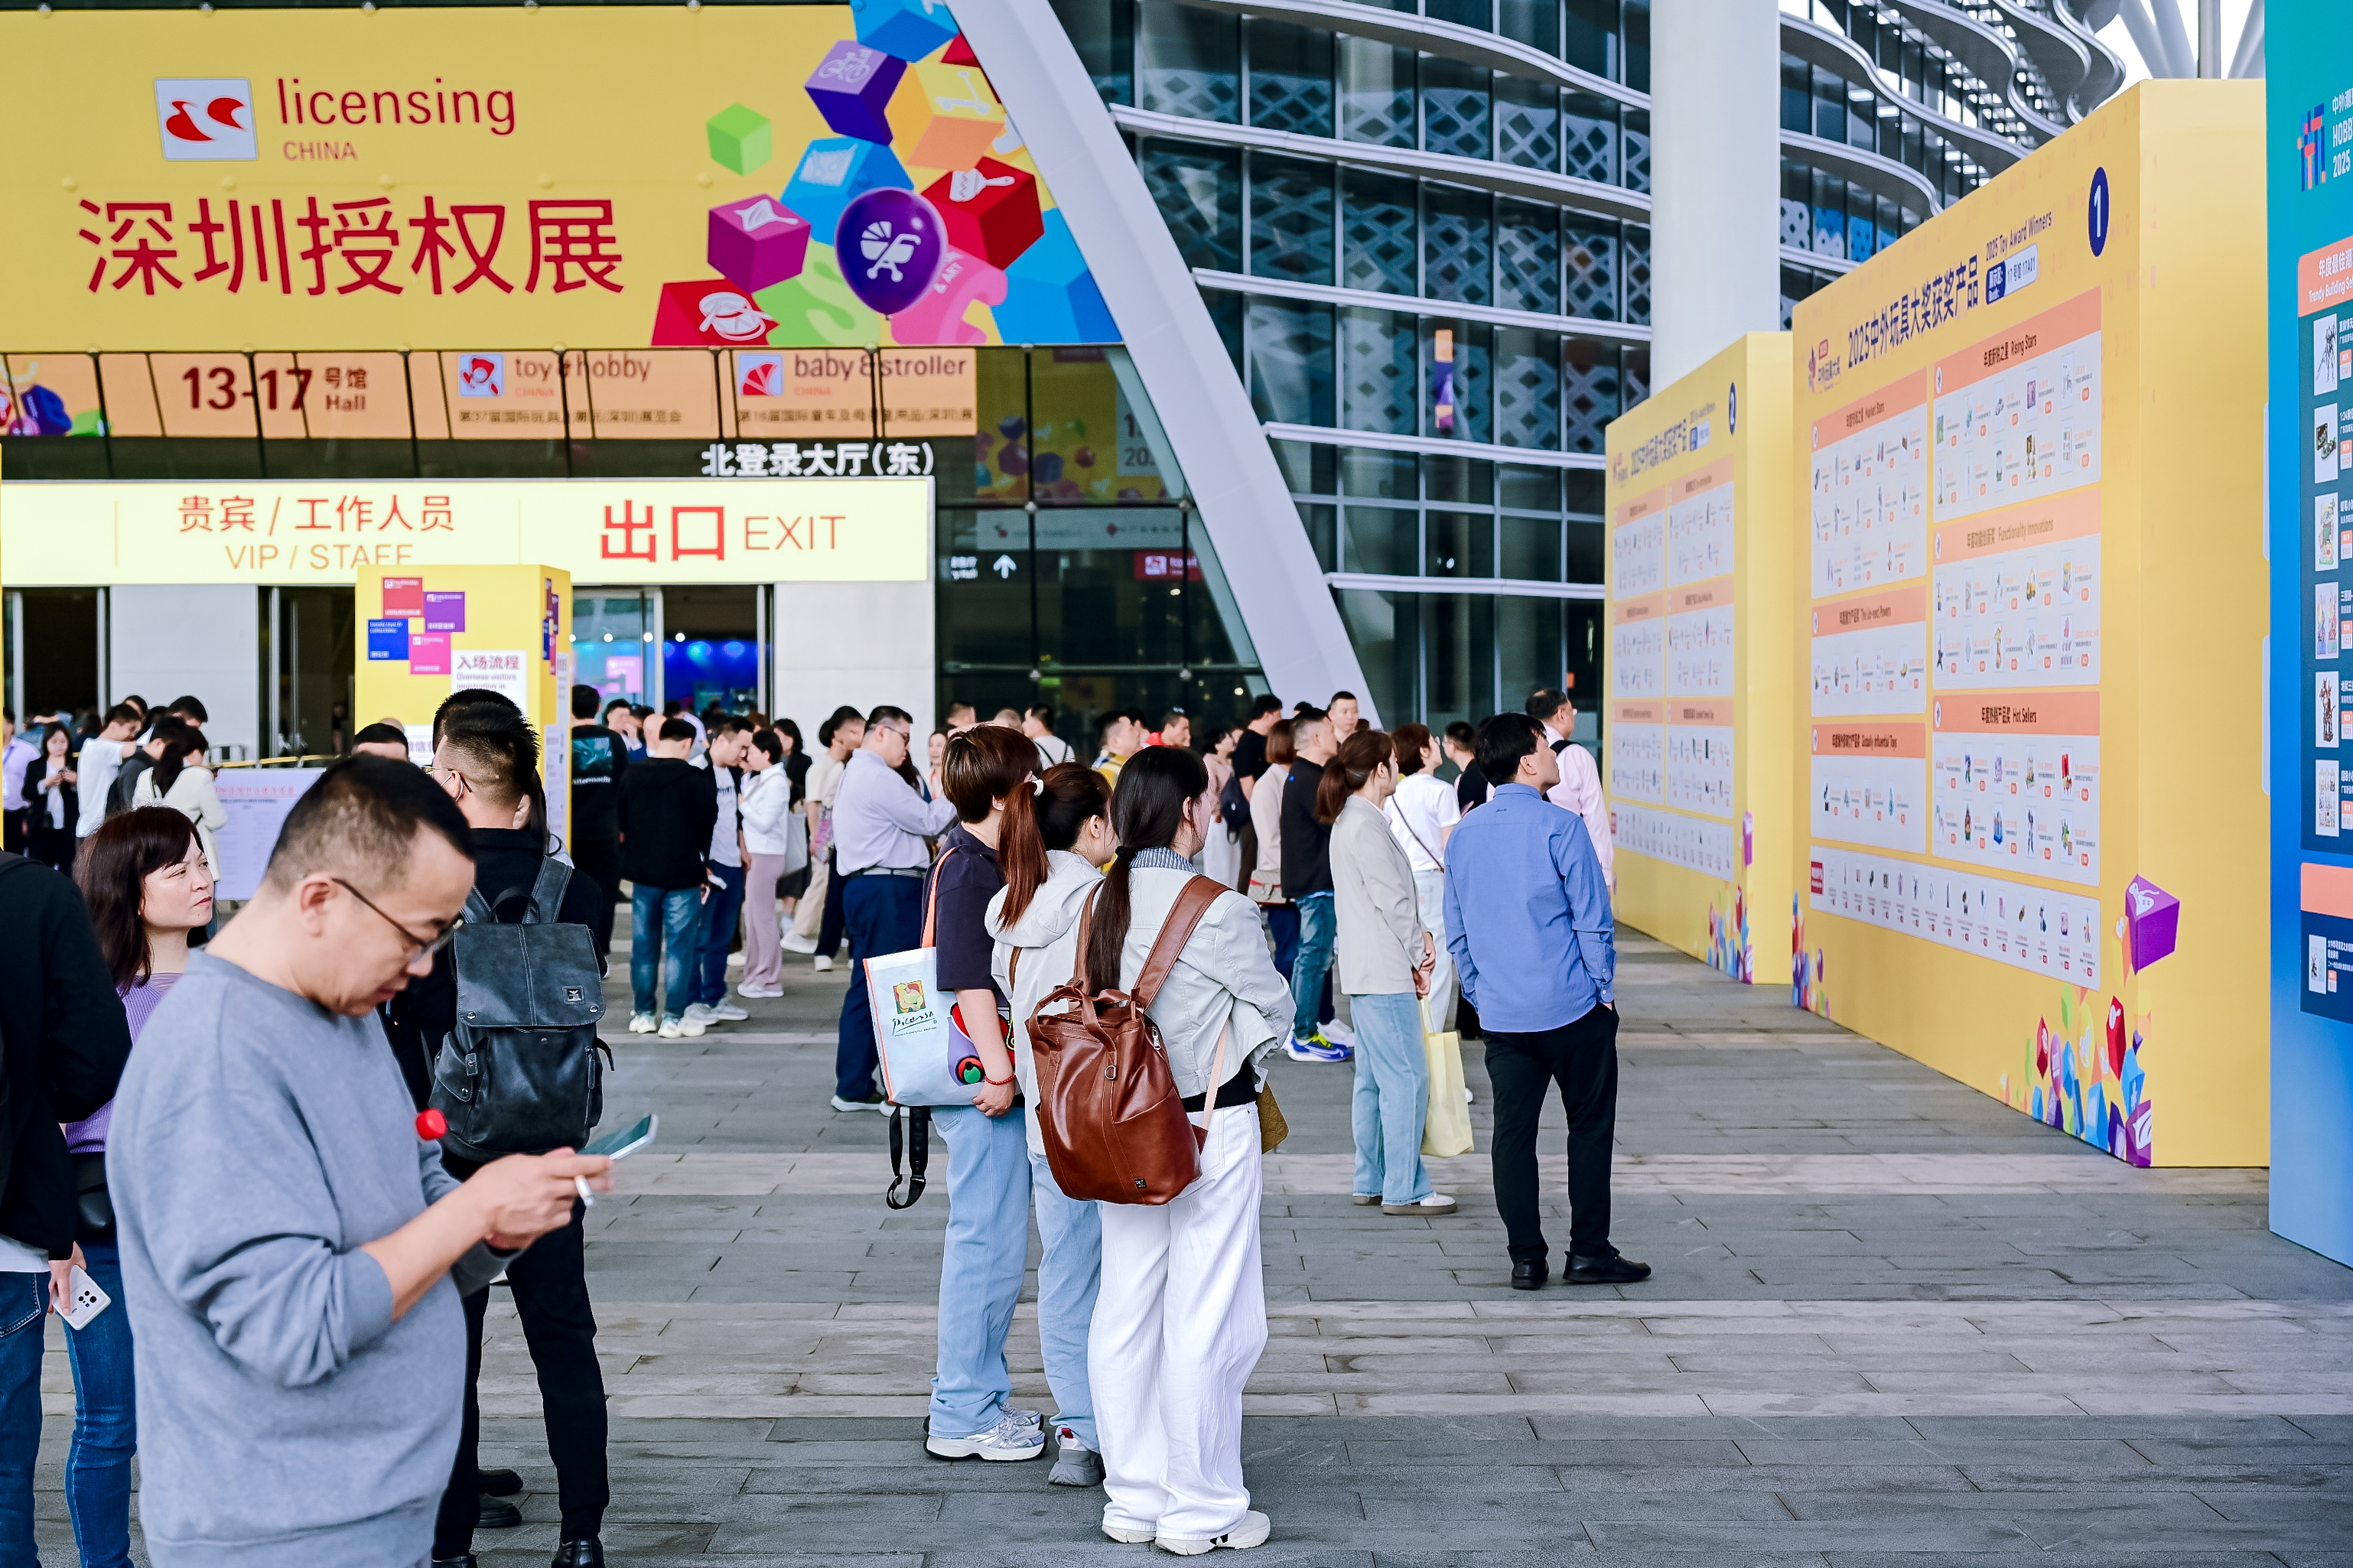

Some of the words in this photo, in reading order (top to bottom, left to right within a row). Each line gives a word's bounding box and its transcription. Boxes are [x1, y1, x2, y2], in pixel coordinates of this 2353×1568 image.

[277, 77, 516, 135] licensing
[2332, 116, 2353, 148] HOBB
[282, 141, 357, 161] CHINA
[2333, 148, 2351, 178] 2025
[2093, 184, 2102, 238] 1
[78, 195, 625, 296] 深圳授权展
[2000, 234, 2008, 256] Toy
[2010, 220, 2027, 248] Award
[2309, 286, 2325, 303] Trendy
[2325, 280, 2345, 295] Building
[1848, 254, 1979, 369] 2025中外玩具大奖获奖产品
[2011, 340, 2025, 356] Rising
[2025, 334, 2037, 351] Stars
[324, 367, 368, 389] 号馆
[516, 357, 552, 382] toy
[577, 353, 651, 382] hobby
[795, 353, 854, 382] baby
[880, 354, 967, 378] stroller
[183, 367, 313, 411] 13-17
[325, 394, 366, 412] Hall
[701, 443, 934, 477] 北登录大厅(东)
[179, 495, 255, 533] 贵宾
[295, 495, 454, 533] 工作人员
[600, 499, 725, 562] 出口
[745, 516, 846, 550] EXIT
[226, 545, 278, 570] VIP
[310, 544, 413, 570] STAFF
[457, 655, 519, 670] 入场流程
[457, 672, 489, 681] Overseas
[2022, 708, 2037, 723] Sellers
